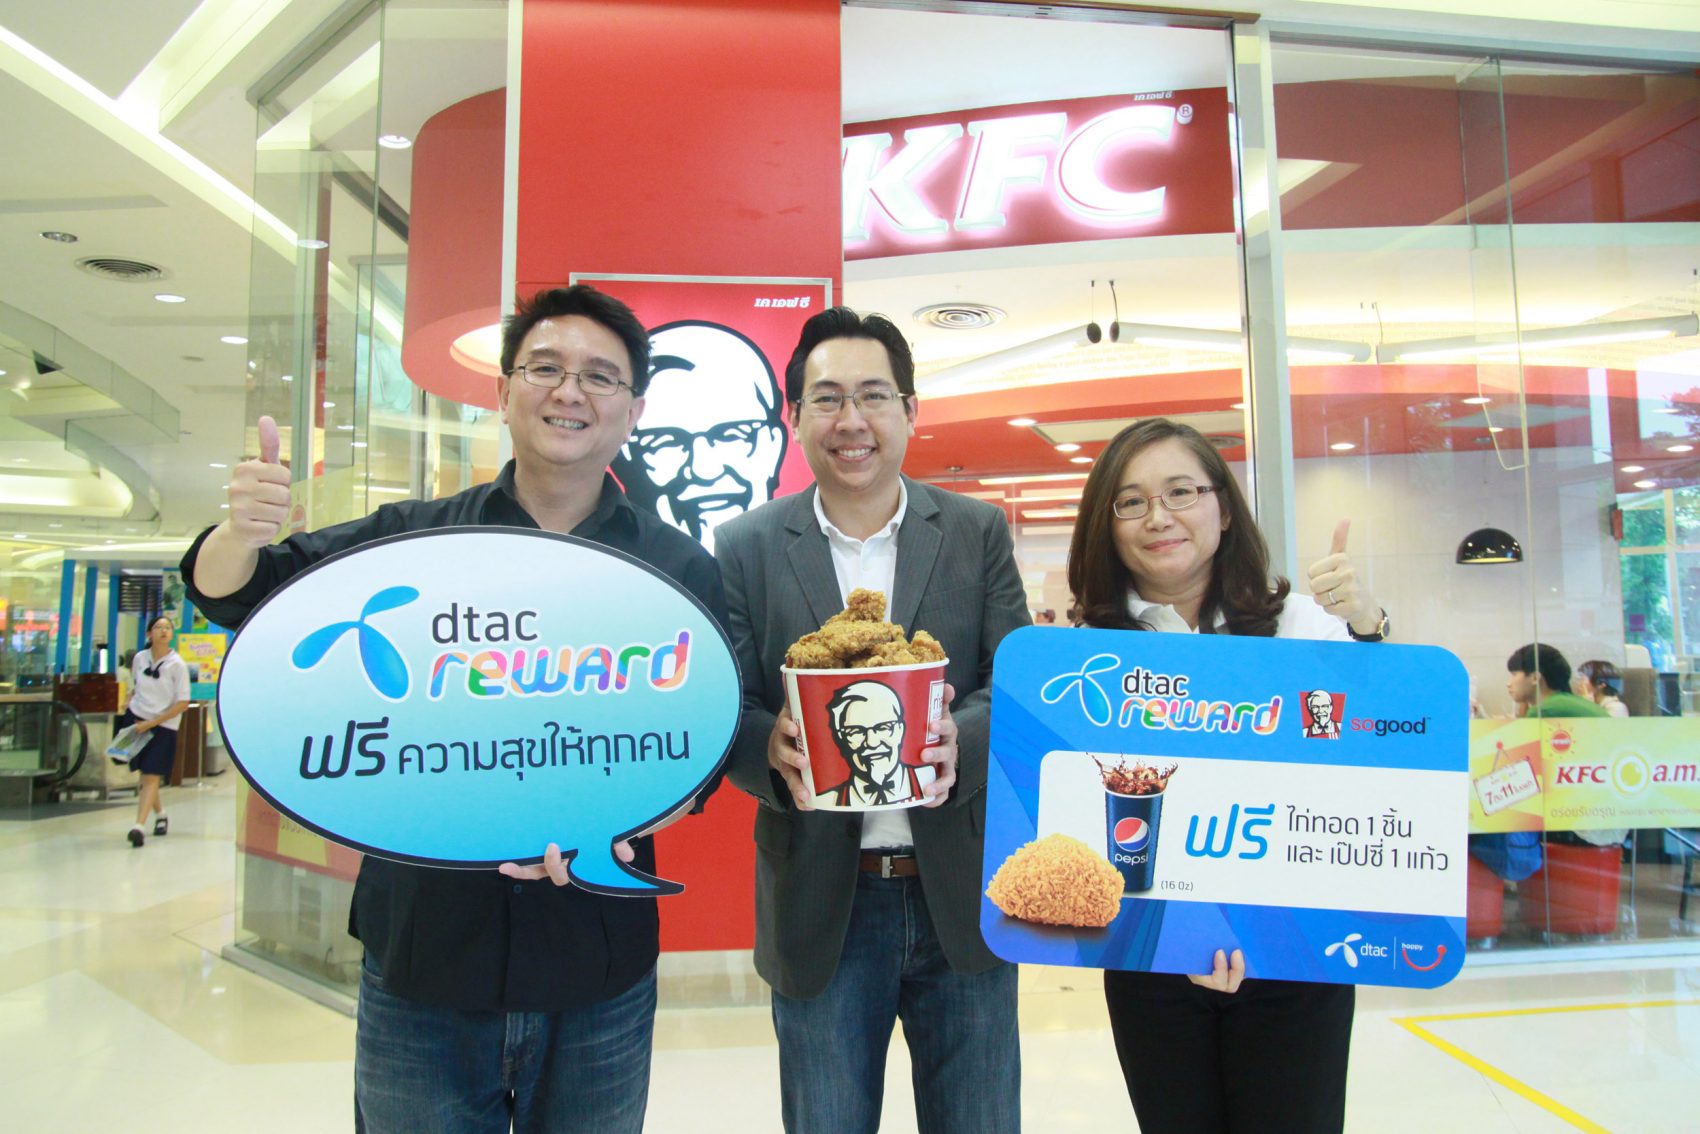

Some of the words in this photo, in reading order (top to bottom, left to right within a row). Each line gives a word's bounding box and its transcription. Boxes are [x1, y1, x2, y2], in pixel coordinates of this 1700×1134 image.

[842, 104, 1176, 240] KFC
[431, 602, 538, 644] dtac
[1123, 668, 1188, 697] dtac
[299, 715, 390, 780] ฟรี
[399, 721, 690, 782] ความสุขให้ทุกคน
[1555, 764, 1608, 785] KFC
[1184, 802, 1276, 860] ฟรี
[1286, 804, 1360, 836] ไก่ทอด
[1367, 815, 1375, 837] 1
[1381, 807, 1413, 839] ชิ้น
[1113, 852, 1150, 867] pepsi
[1286, 844, 1324, 864] และ
[1330, 838, 1384, 868] เป๊ปซี่
[1391, 847, 1399, 869] 1
[1407, 845, 1450, 872] แก้ว
[1360, 942, 1388, 958] dtac
[1401, 942, 1424, 952] happy
